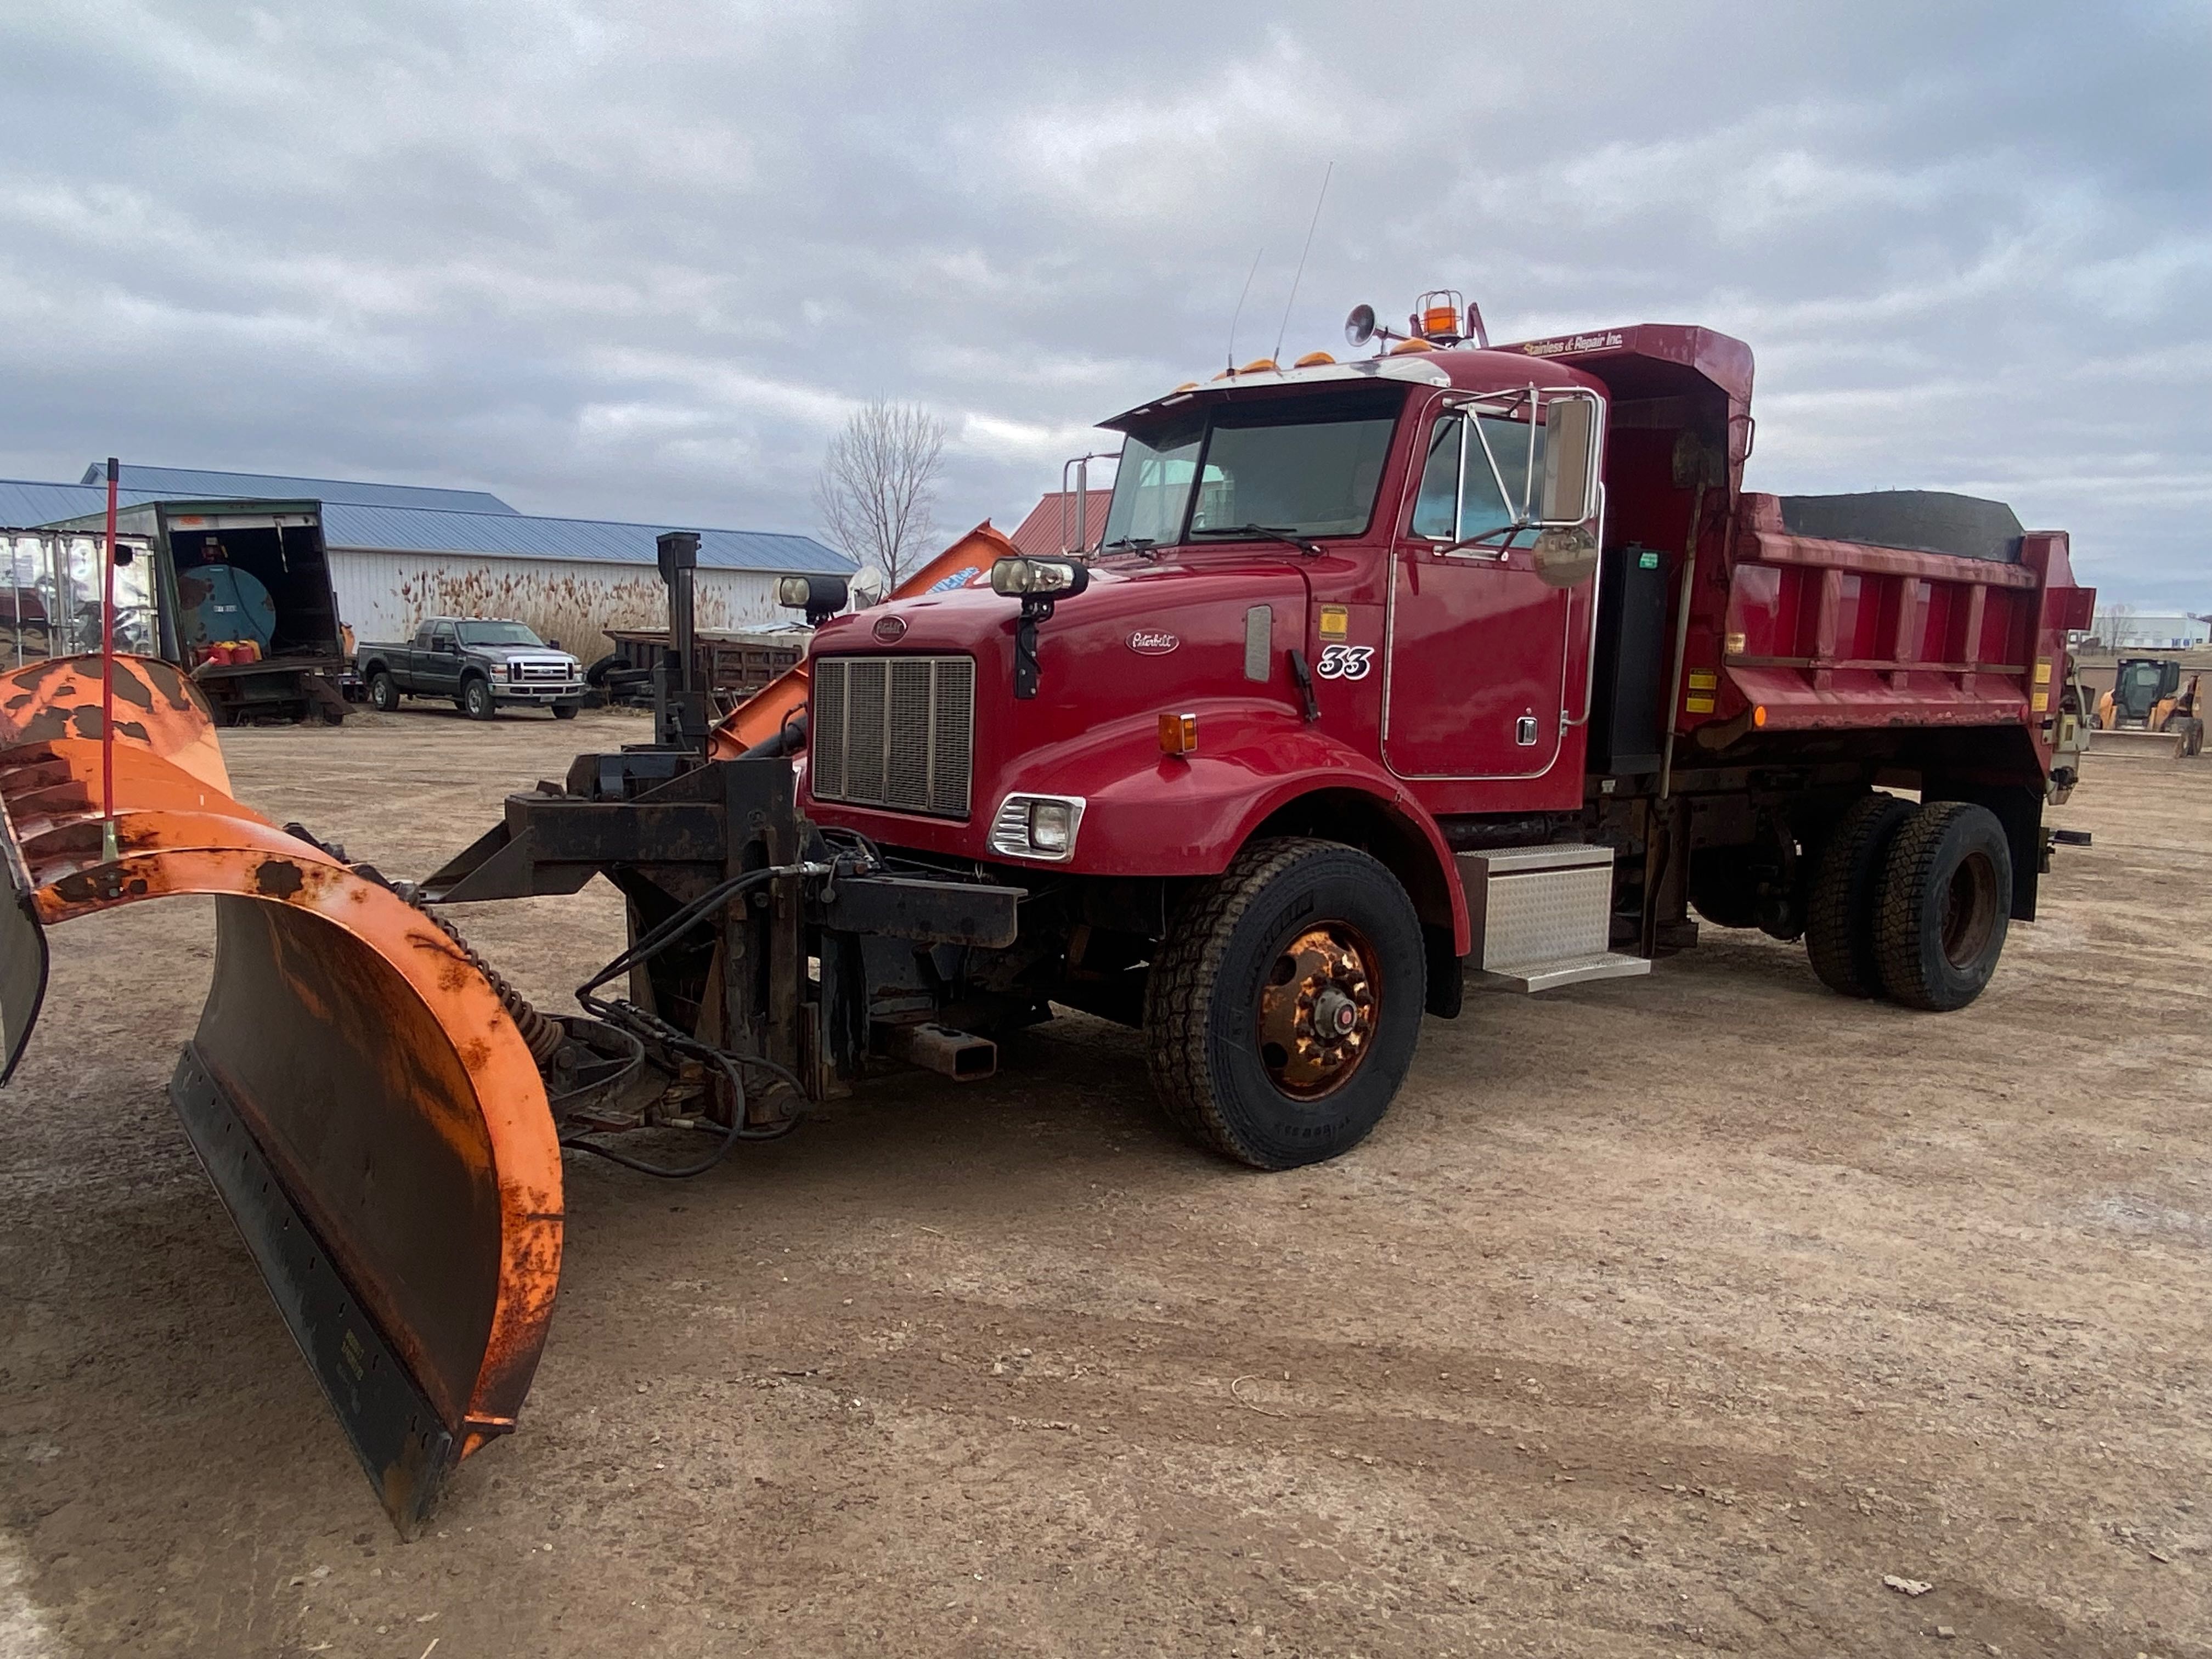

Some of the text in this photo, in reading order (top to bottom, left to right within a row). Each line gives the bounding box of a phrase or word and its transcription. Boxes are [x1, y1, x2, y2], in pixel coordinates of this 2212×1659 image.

[1523, 331, 1623, 356] Stainless & Repair Inc.
[1132, 632, 1175, 648] Peterbilt
[1317, 645, 1374, 680] 33
